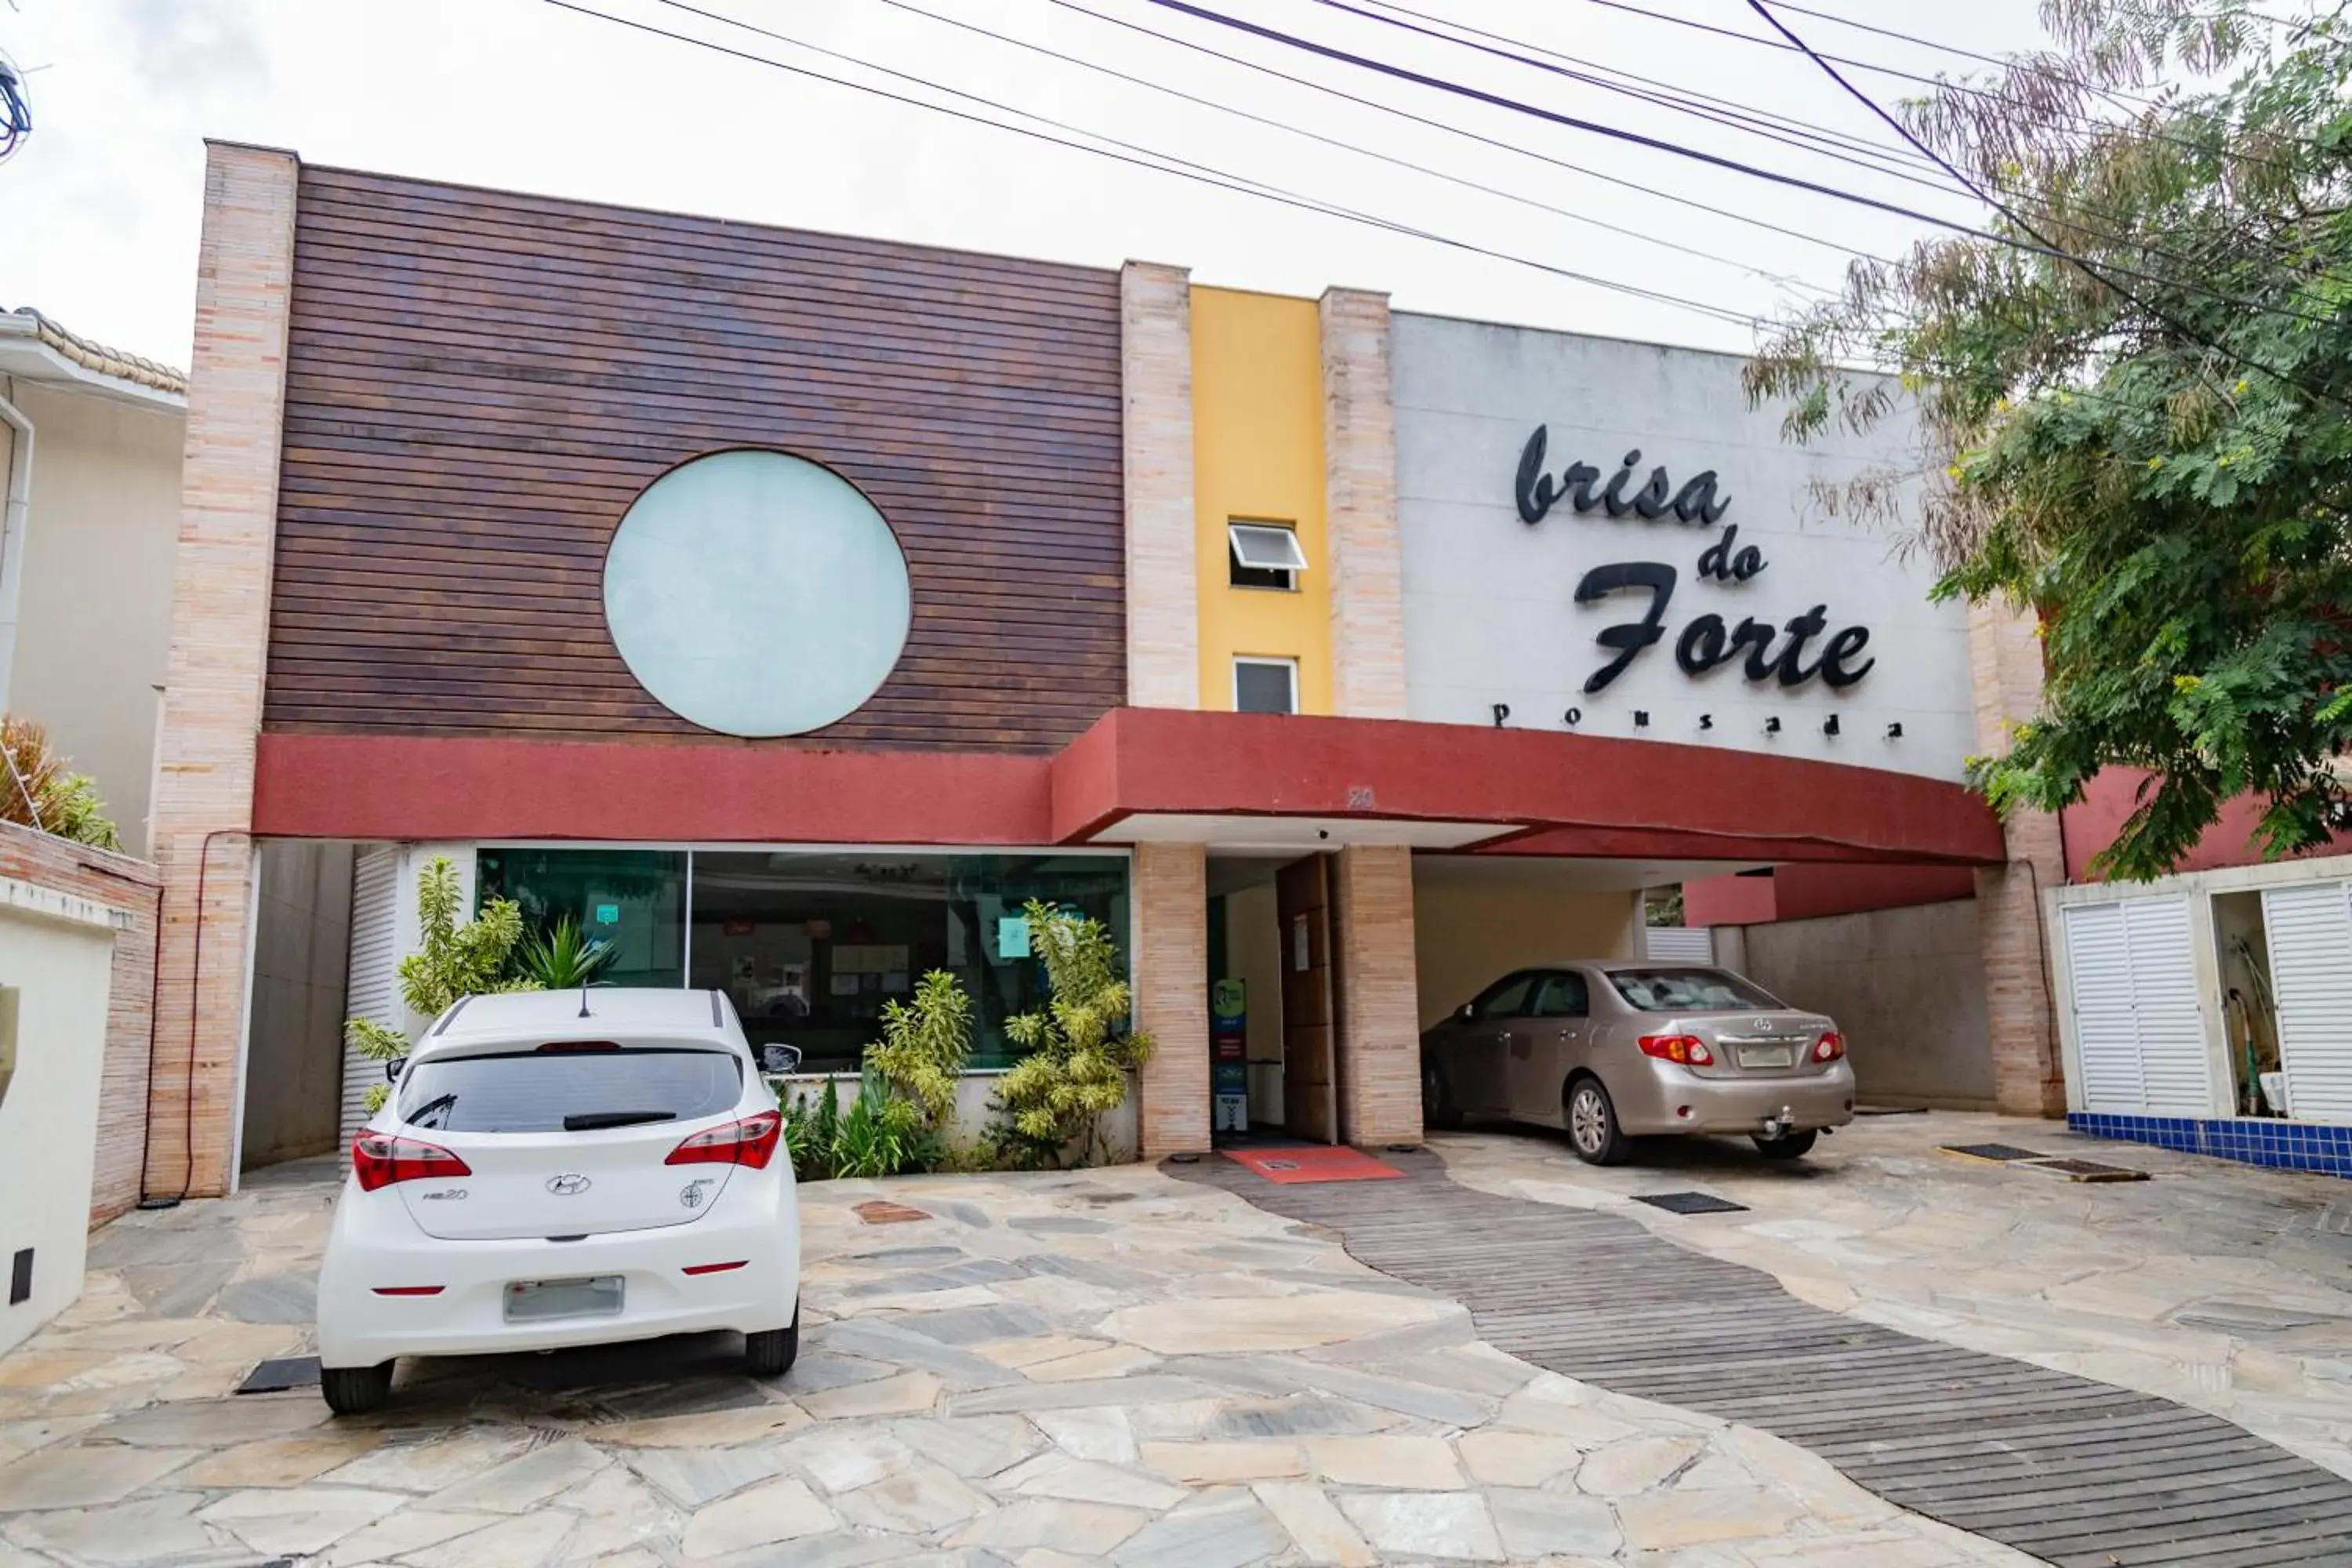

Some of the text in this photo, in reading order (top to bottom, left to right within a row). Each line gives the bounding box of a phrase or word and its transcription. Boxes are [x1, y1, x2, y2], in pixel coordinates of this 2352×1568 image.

[1515, 424, 1731, 524] brisa
[1697, 524, 1769, 581] do
[1574, 561, 1875, 693] Forte
